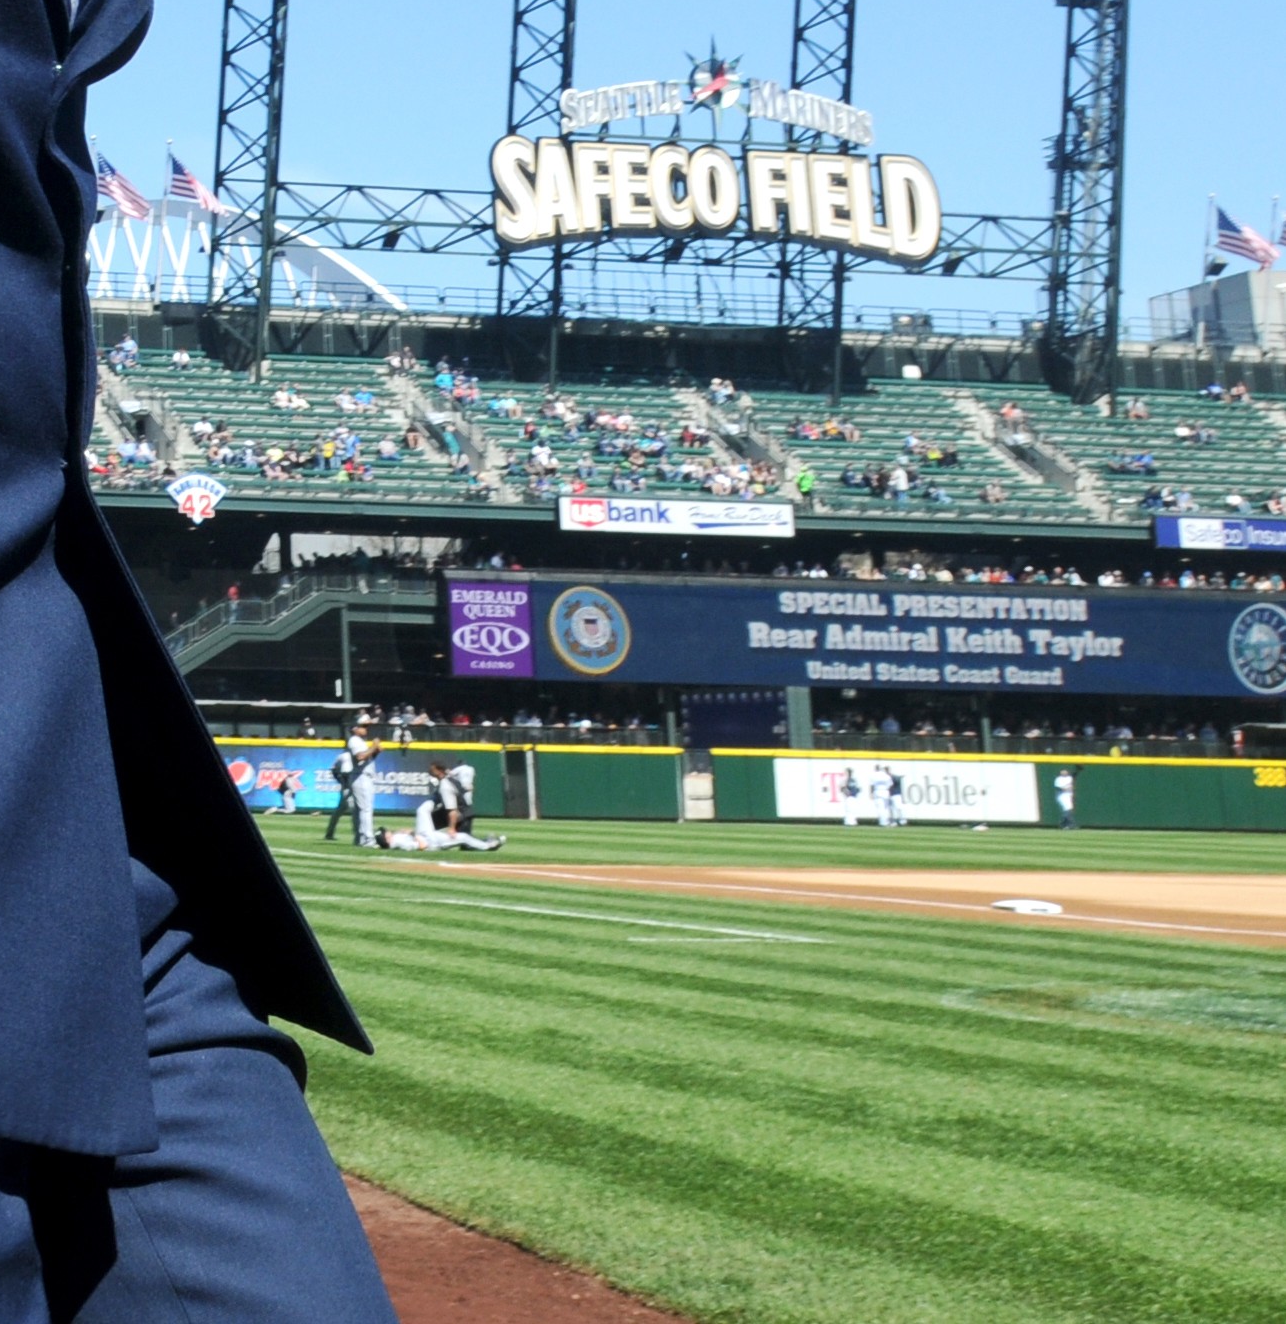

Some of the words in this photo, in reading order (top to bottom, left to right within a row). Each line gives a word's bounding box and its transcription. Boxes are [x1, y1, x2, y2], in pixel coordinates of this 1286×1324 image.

[560, 80, 684, 133] SEATTLE
[747, 78, 874, 147] MARINERS
[490, 135, 740, 252] SAFECO
[744, 149, 943, 266] FIELD
[180, 493, 213, 517] 42
[1185, 523, 1243, 544] Safeco
[451, 589, 528, 606] EMERALD
[779, 591, 888, 617] SPECIAL
[893, 594, 1089, 622] PRESENTATION
[462, 604, 517, 620] QUEEN
[748, 621, 819, 649] Rear
[825, 623, 939, 653] Admiral
[945, 627, 1024, 654] Keith
[1029, 629, 1125, 662] Taylor
[806, 660, 873, 681] United
[876, 662, 941, 683] States
[943, 664, 1001, 683] Coast
[1004, 666, 1064, 686] Guard
